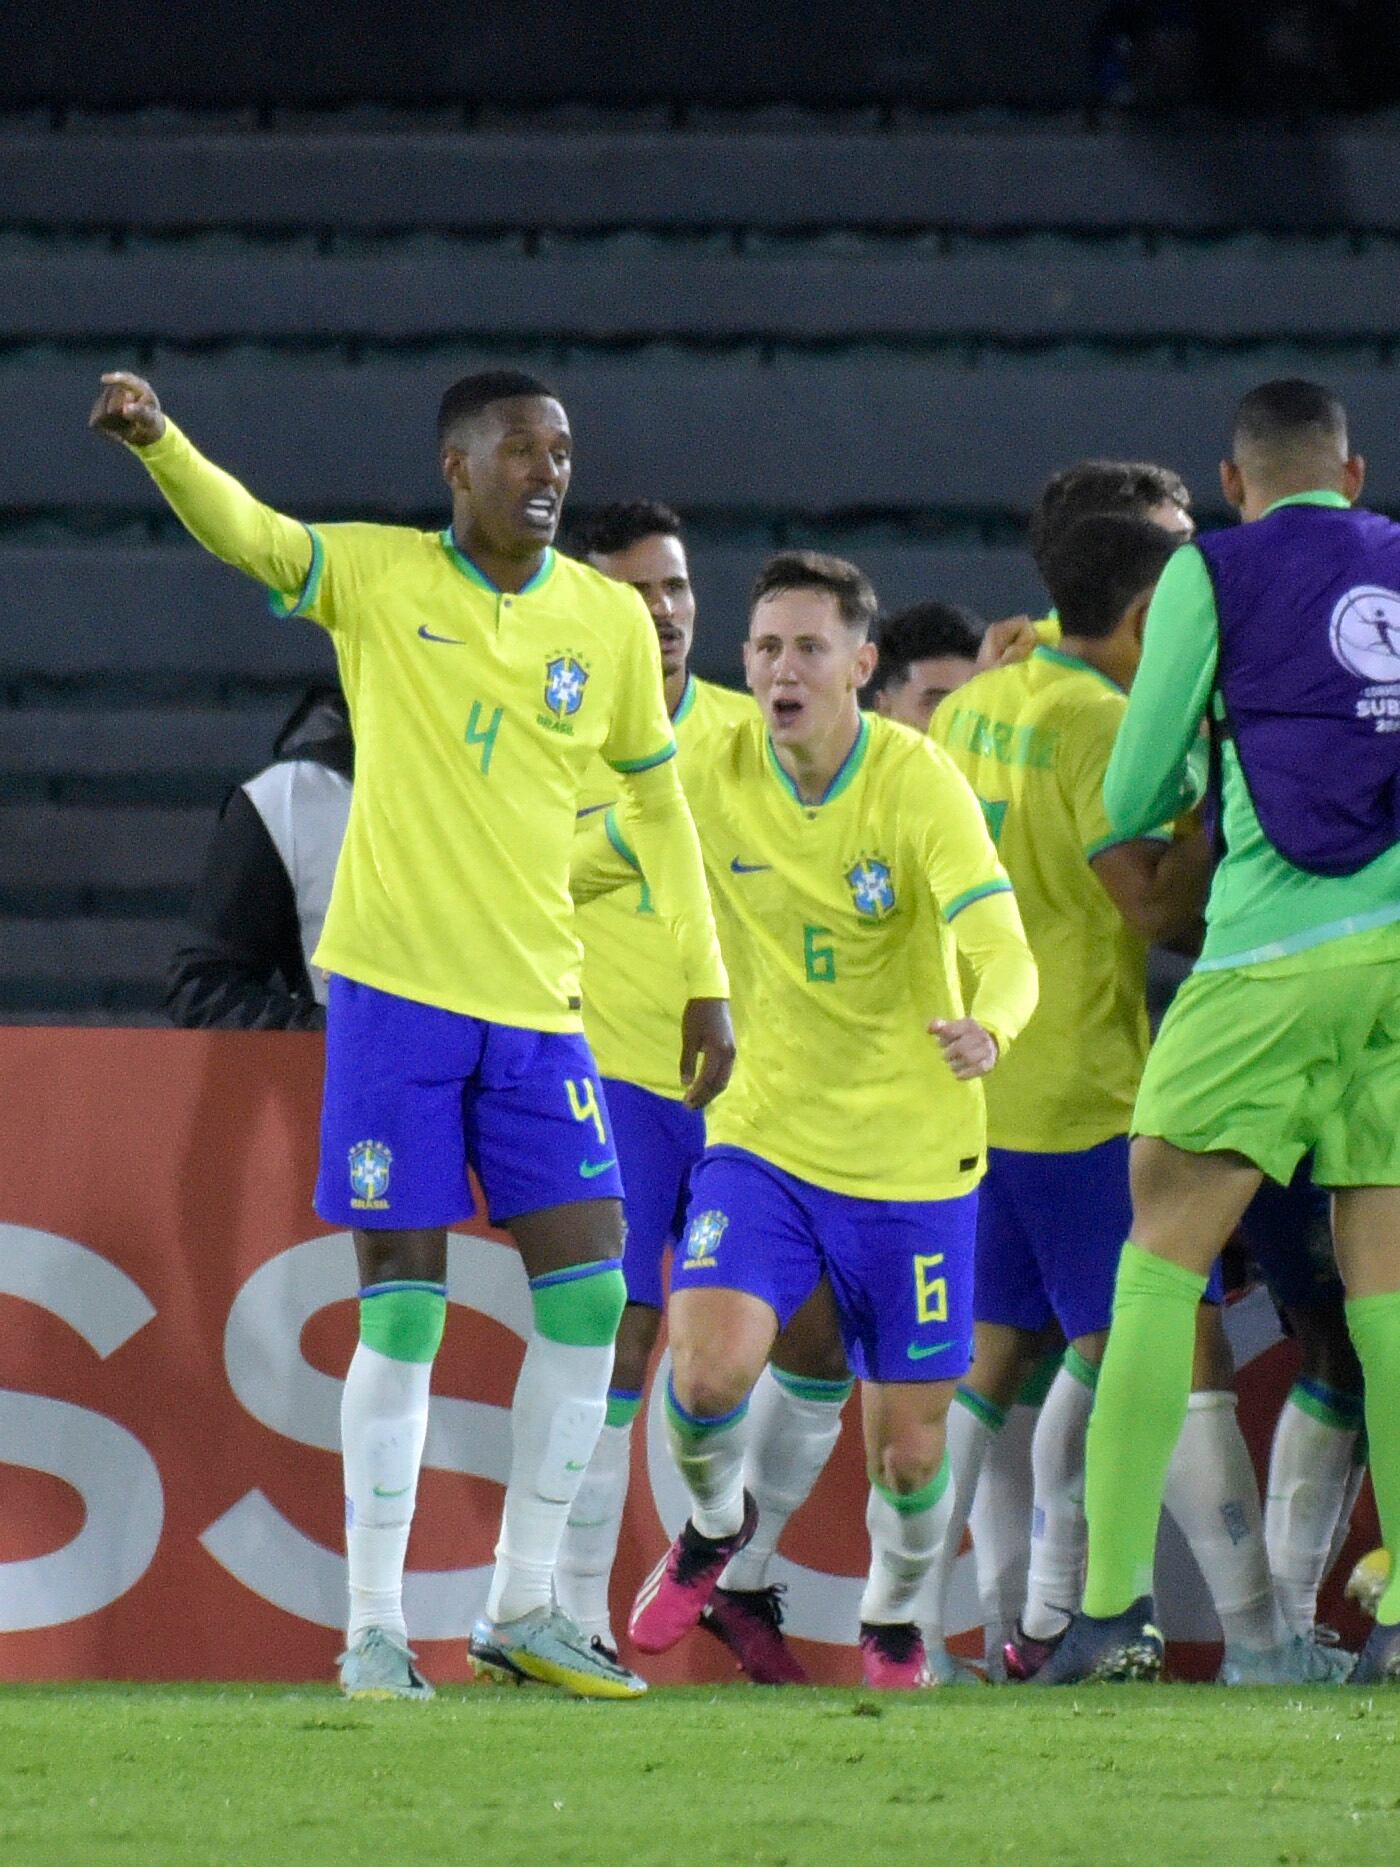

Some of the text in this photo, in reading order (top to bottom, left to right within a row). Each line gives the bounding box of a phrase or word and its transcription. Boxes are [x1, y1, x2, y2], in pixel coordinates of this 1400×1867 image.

[465, 699, 504, 776] 4
[803, 923, 836, 983] 6
[564, 1077, 607, 1145] 4
[351, 1198, 391, 1210] BRASIL
[914, 1252, 948, 1324] 6
